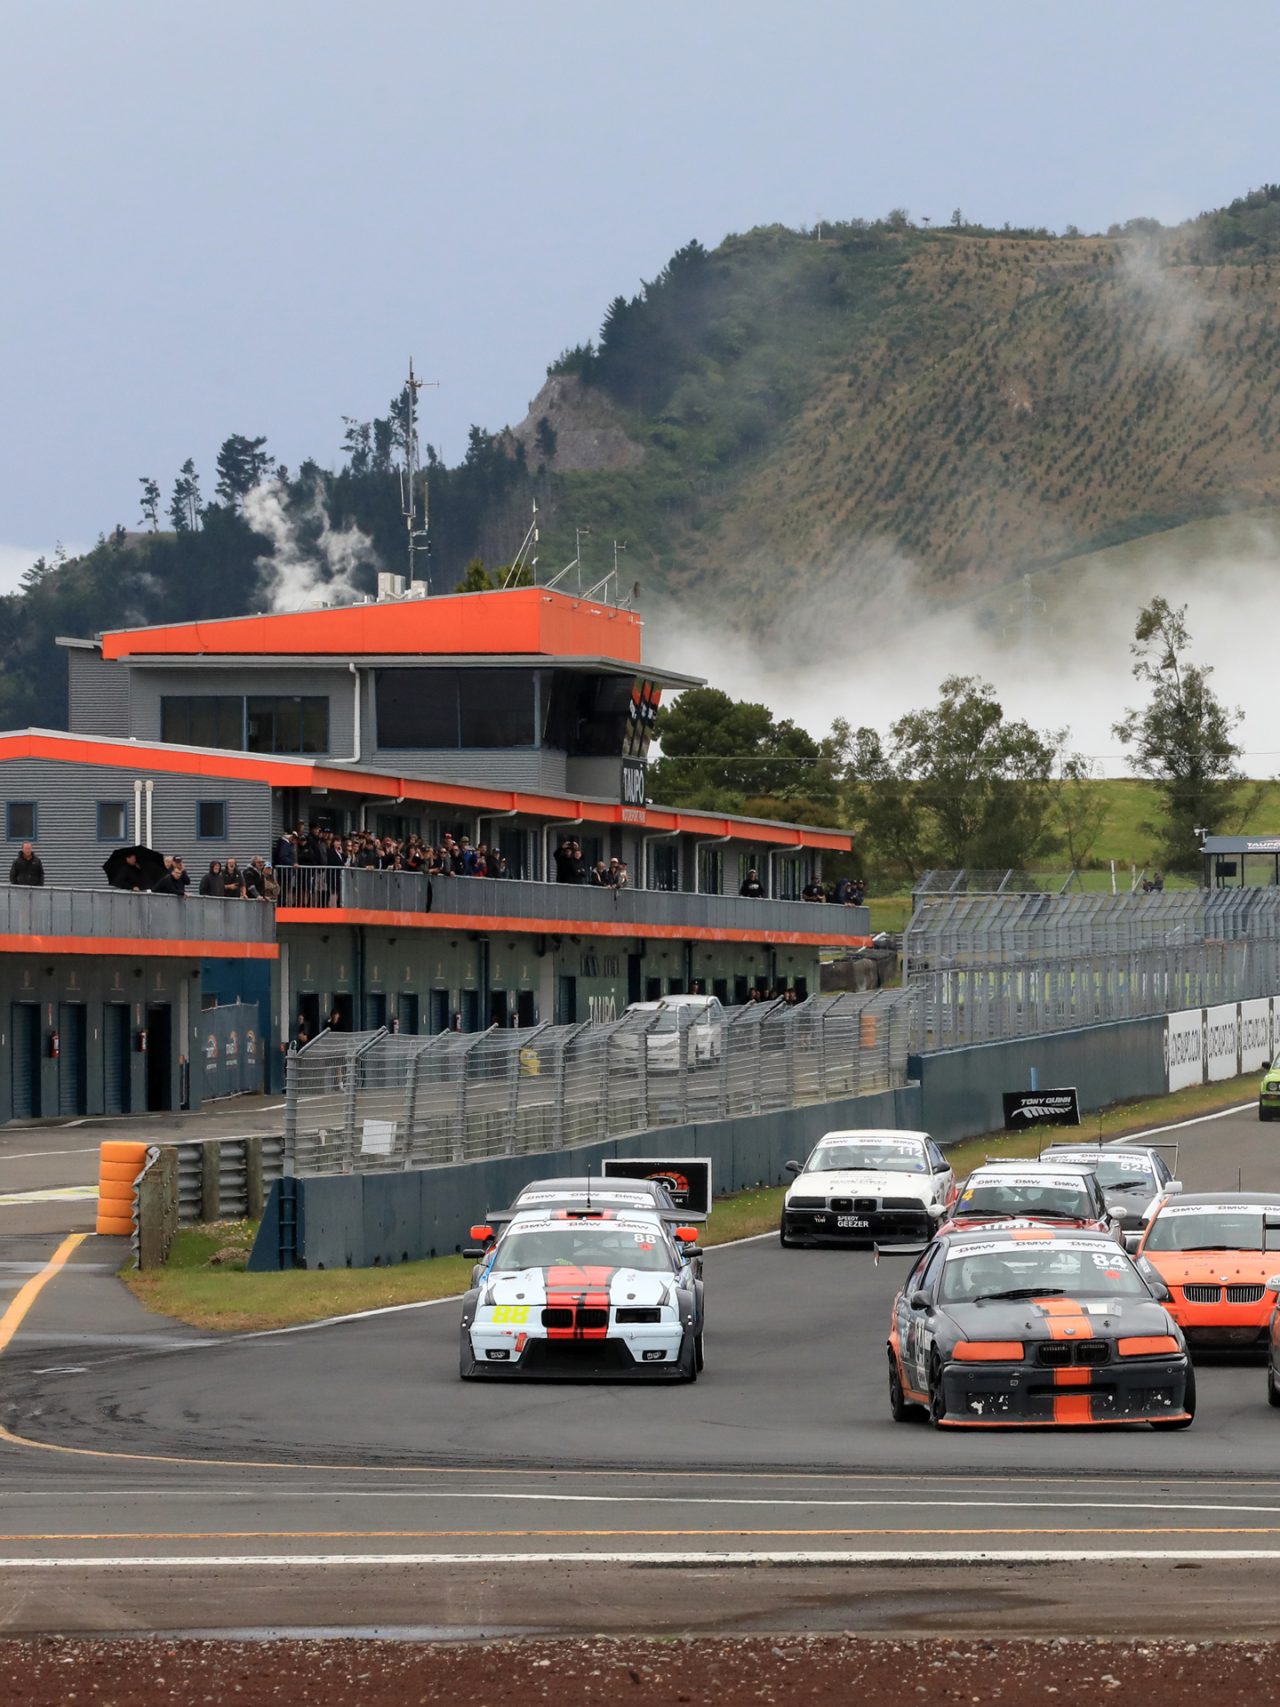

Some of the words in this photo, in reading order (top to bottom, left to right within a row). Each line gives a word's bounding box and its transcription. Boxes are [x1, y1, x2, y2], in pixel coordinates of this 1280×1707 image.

[1021, 1098, 1045, 1106] TONY
[1045, 1096, 1072, 1104] QUINN
[897, 1147, 924, 1158] 112
[1120, 1162, 1152, 1174] 525
[837, 1220, 870, 1228] GEEZER
[633, 1233, 657, 1244] 88
[1091, 1253, 1128, 1269] 84
[491, 1305, 530, 1324] 88
